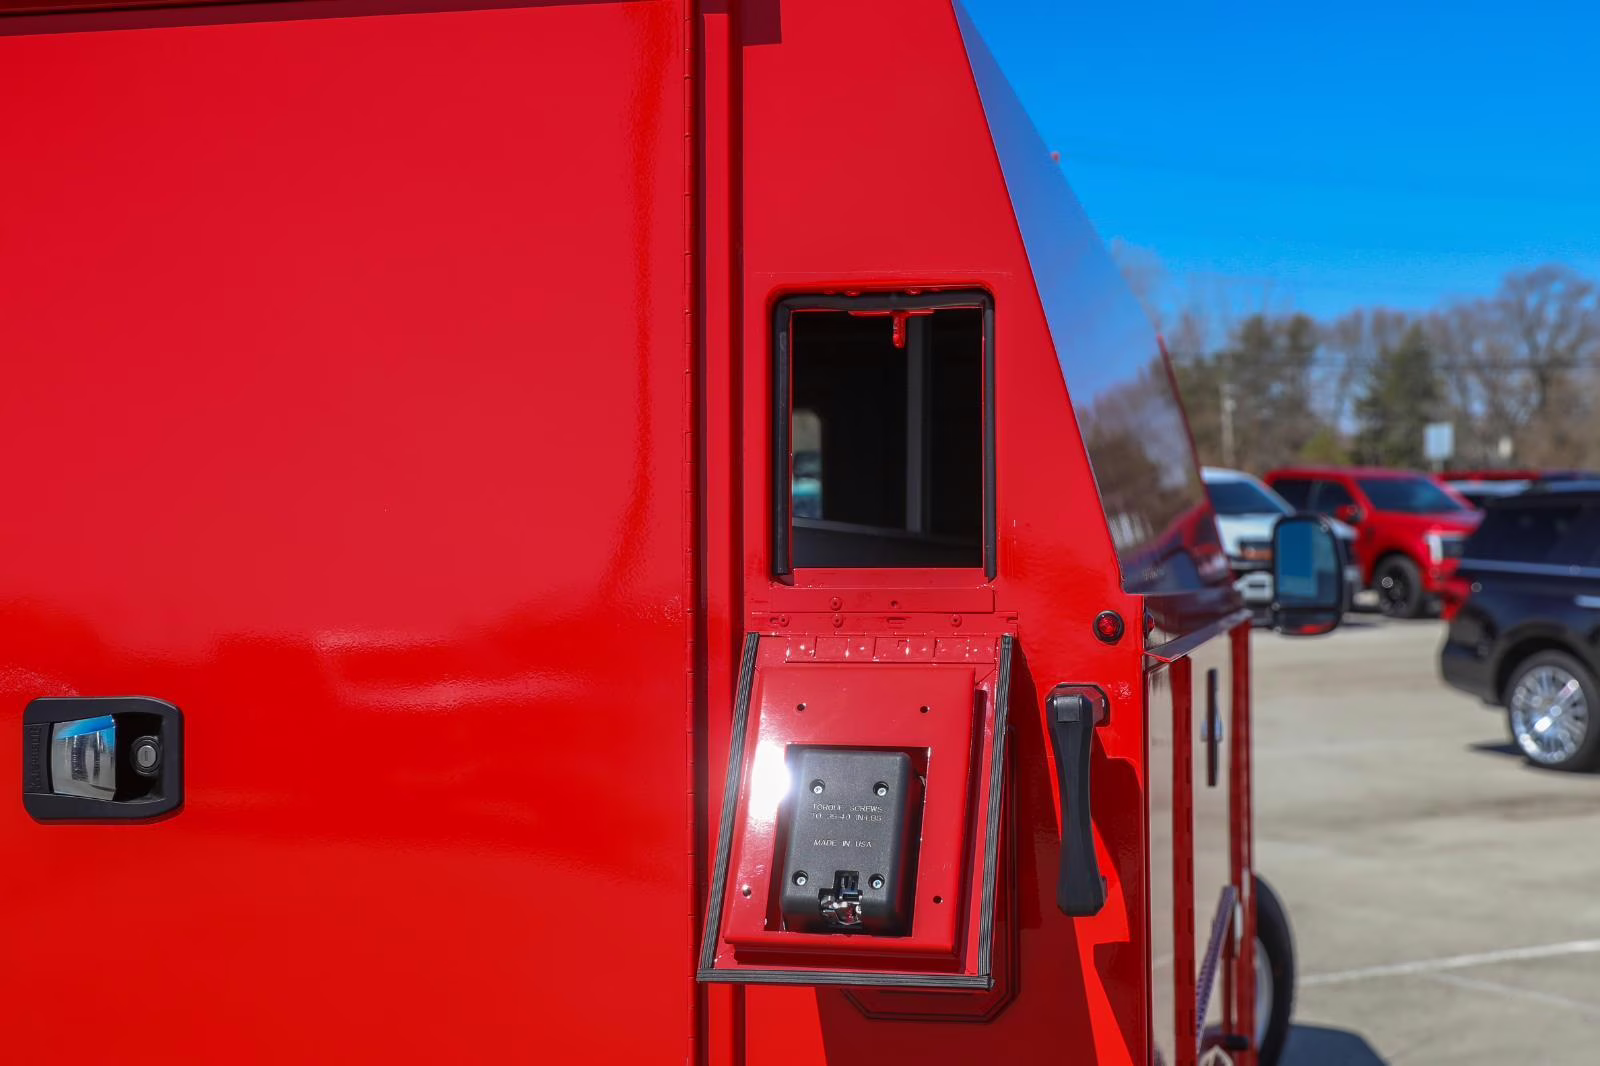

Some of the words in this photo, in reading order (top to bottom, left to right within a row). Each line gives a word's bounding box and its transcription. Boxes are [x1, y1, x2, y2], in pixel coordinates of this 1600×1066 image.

[813, 803, 842, 811] TORQUE
[849, 804, 883, 813] SCREWS
[812, 812, 822, 820] TO
[813, 839, 837, 847] MADE
[842, 840, 851, 848] IN
[855, 840, 872, 848] USA
